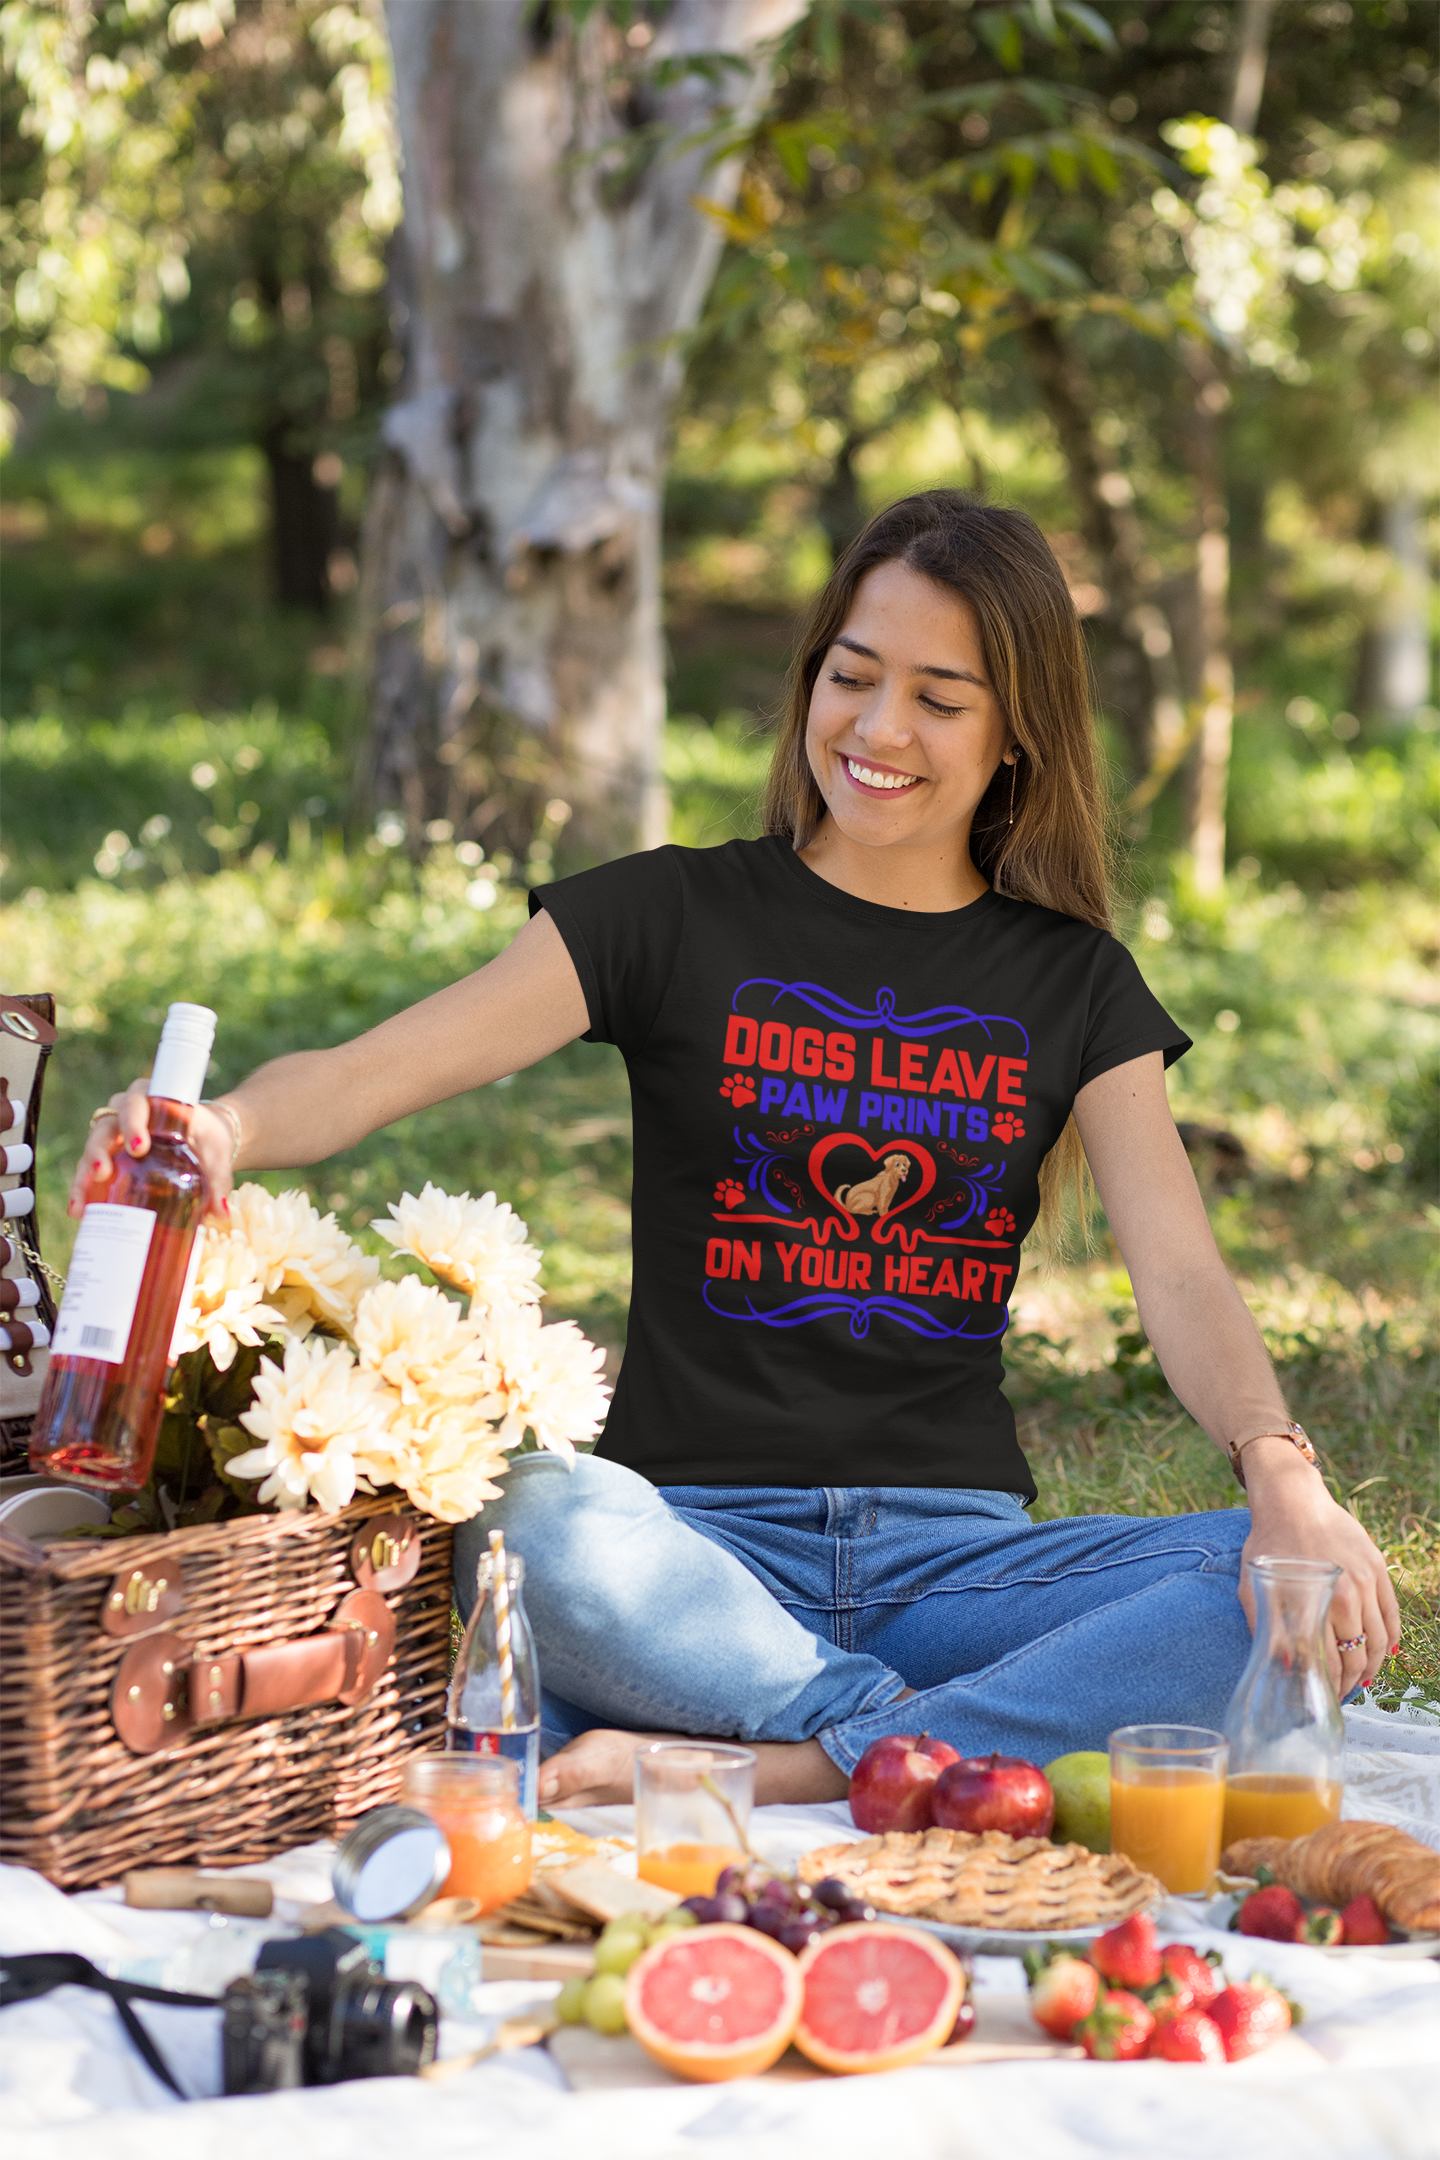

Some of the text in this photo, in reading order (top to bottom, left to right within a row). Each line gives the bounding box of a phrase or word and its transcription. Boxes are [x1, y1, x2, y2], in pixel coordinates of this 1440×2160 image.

[723, 1014, 1028, 1107] DOGS LEAVE
[759, 1077, 989, 1143] PAW PRINTS
[705, 1237, 1012, 1304] ON YOUR HEART
